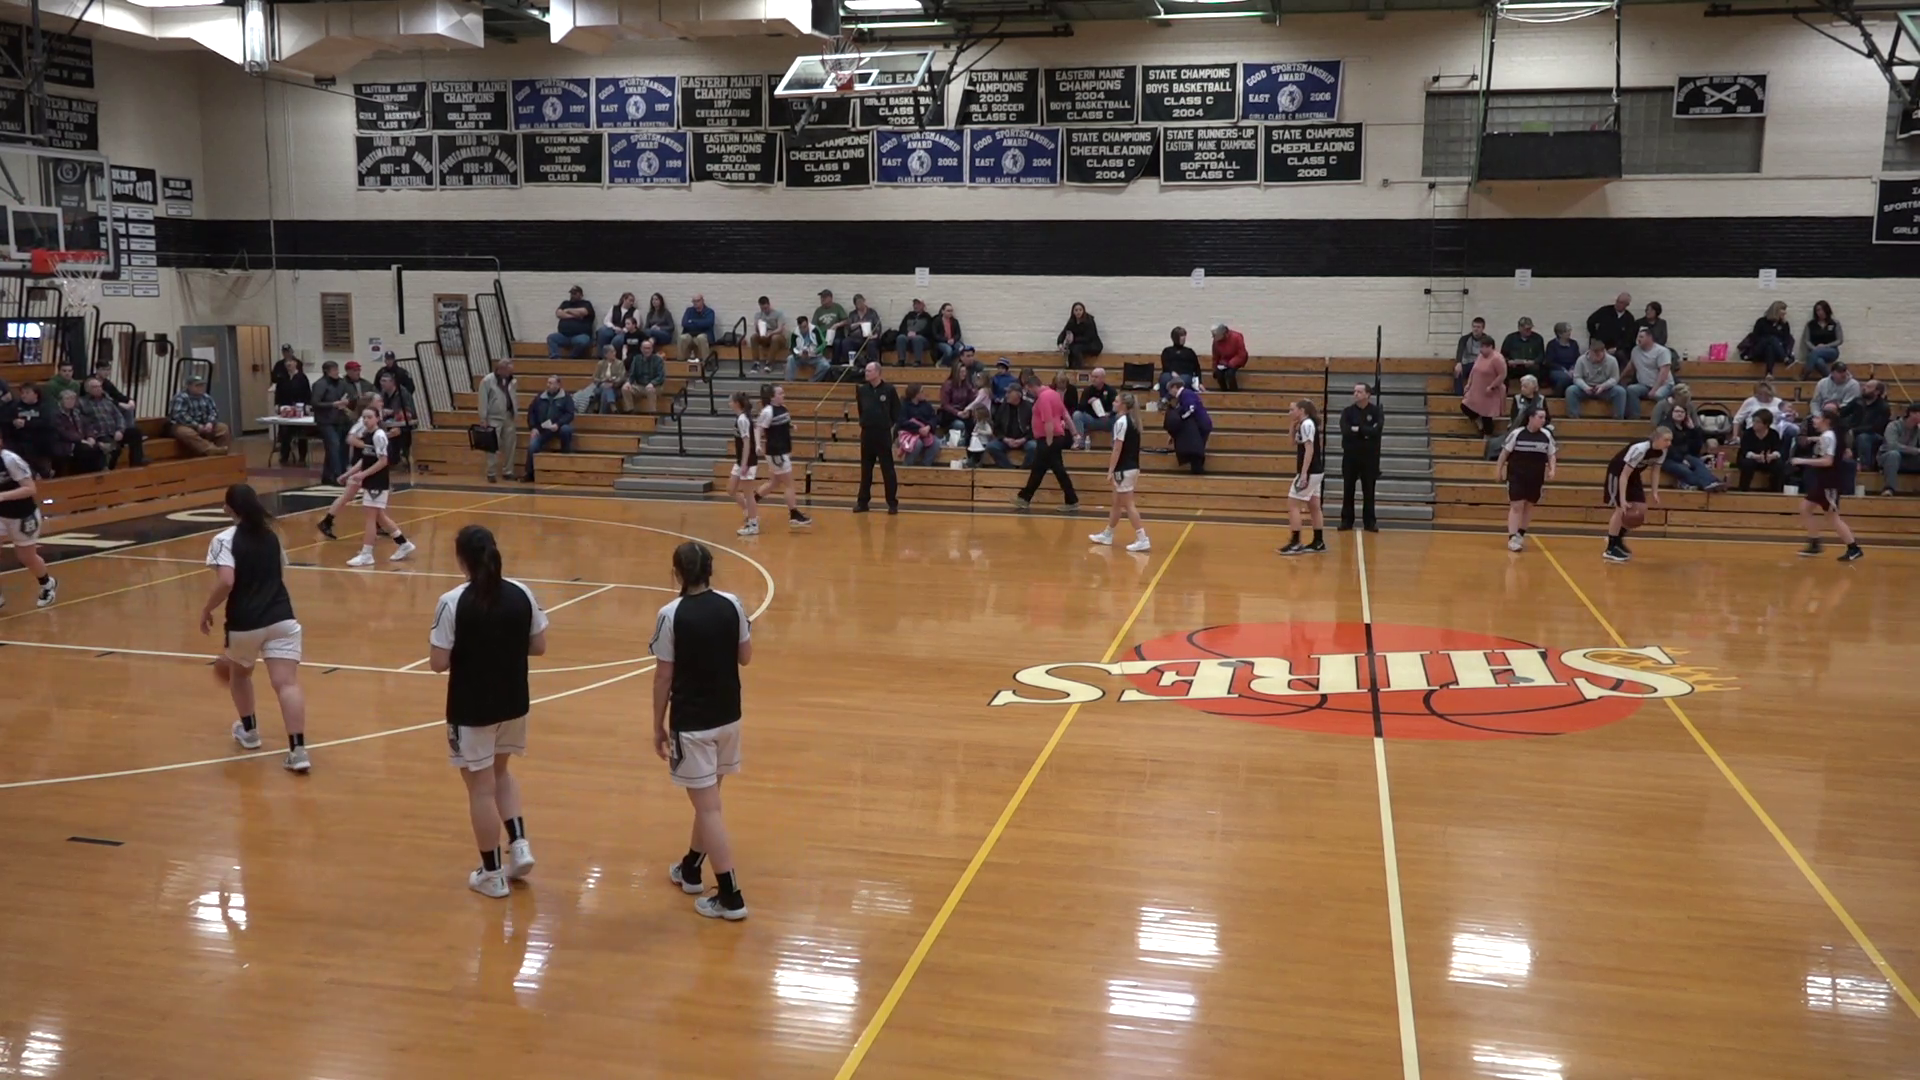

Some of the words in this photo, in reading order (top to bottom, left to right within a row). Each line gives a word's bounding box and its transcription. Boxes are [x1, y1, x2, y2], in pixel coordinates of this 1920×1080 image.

[1002, 71, 1028, 81] MAINE
[1055, 71, 1095, 81] EASTERN
[1099, 69, 1125, 79] MAINE
[1149, 70, 1177, 80] STATE
[1180, 68, 1230, 79] CHAMPIONS
[1246, 70, 1267, 86] GOOD
[1271, 63, 1335, 84] SPORTSMANSHIP
[1278, 73, 1305, 82] AWARD
[432, 82, 473, 92] EASTERN
[478, 81, 507, 91] MAINE
[682, 77, 728, 88] EASTERN
[730, 76, 762, 87] MAINE
[1059, 80, 1121, 91] CHAMPIONS
[362, 85, 391, 93] EASTERN
[397, 84, 417, 92] MAINE
[535, 79, 588, 99] SPORTSMANSHIP
[540, 87, 563, 95] AWARD
[619, 78, 672, 98] SPORTSMANSHIP
[625, 86, 647, 94] AWARD
[1146, 83, 1169, 94] BOYS
[1173, 81, 1232, 93] BASKETBALL
[444, 92, 495, 103] CHAMPIONS
[694, 88, 751, 99] CHAMPIONS
[980, 94, 1009, 102] 2003
[1075, 91, 1105, 100] 2004
[373, 94, 408, 103] CHAMPIONS
[864, 97, 887, 106] GIRLS
[1164, 96, 1201, 105] CLASS
[1206, 96, 1214, 104] C
[1249, 94, 1270, 103] EAST
[601, 104, 618, 112] EAST
[714, 100, 732, 108] 1997
[992, 103, 1024, 112] SOCCER
[1050, 101, 1072, 110] BOYS
[1075, 100, 1131, 109] BASKETBALL
[518, 105, 535, 113] EAST
[696, 109, 750, 117] CHEERLEADING
[879, 107, 914, 116] CLASS
[1172, 108, 1204, 118] 2004
[46, 109, 89, 124] HAMPIONS
[359, 112, 377, 120] GIRLS
[447, 112, 465, 120] GIRLS
[468, 112, 491, 120] SOCCER
[971, 113, 1006, 122] CLASS
[1009, 113, 1017, 121] C
[1067, 111, 1103, 120] CLASS
[1106, 110, 1114, 119] C
[377, 121, 399, 129] CLASS
[455, 121, 475, 129] CLASS
[707, 118, 729, 126] CLASS
[887, 117, 915, 125] 2002
[703, 134, 739, 144] EASTERN
[742, 133, 766, 143] MAINE
[1072, 132, 1099, 143] STATE
[1102, 131, 1151, 142] CHAMPIONS
[1167, 129, 1194, 140] STATE
[1197, 128, 1254, 139] RUNNERS-UP
[1272, 129, 1301, 140] STATE
[1306, 128, 1354, 139] CHAMPIONS
[536, 136, 566, 145] EASTERN
[569, 136, 589, 144] MAINE
[630, 133, 684, 153] SPORTSMANSHIP
[880, 138, 898, 153] GOOD
[901, 132, 961, 152] SPORTSMANSHIP
[973, 135, 993, 151] GOOD
[995, 128, 1055, 150] SPORTSMANSHIP
[1002, 138, 1028, 147] AWARD
[544, 145, 581, 154] CHAMPIONS
[636, 141, 659, 150] AWARD
[706, 144, 762, 154] CHAMPIONS
[907, 141, 932, 149] AWARD
[1165, 141, 1194, 151] EASTERN
[1197, 141, 1217, 150] MAINE
[1220, 140, 1256, 150] CHAMPIONS
[1271, 142, 1355, 154] CHEERLEADING
[790, 148, 865, 161] CHEERLEADING
[1070, 144, 1153, 156] CHEERLEADING
[358, 147, 407, 174] SPORTSMANSHIP
[412, 151, 434, 174] AWARD
[440, 146, 491, 174] SPORTSMANSHIP
[494, 149, 518, 174] AWARD
[722, 155, 747, 163] 2001
[1194, 152, 1225, 161] 2004
[1287, 156, 1325, 166] CLASS
[1329, 156, 1337, 164] C
[614, 159, 631, 168] EAST
[882, 158, 902, 166] EAST
[937, 158, 959, 166] 2002
[975, 158, 995, 166] EAST
[1032, 158, 1052, 166] 2004
[1086, 158, 1123, 168] CLASS
[1127, 158, 1135, 167] C
[1180, 160, 1240, 171] SOFTBALL
[539, 164, 587, 173] CHEERLEADING
[706, 163, 762, 172] CHEERLEADING
[804, 162, 840, 172] CLASS
[548, 173, 570, 182] CLASS
[712, 172, 745, 181] CLASS
[813, 174, 842, 183] 2002
[1095, 170, 1125, 179] 2004
[1185, 170, 1223, 180] CLASS
[1226, 170, 1235, 179] C
[364, 176, 381, 186] GIRLS
[390, 176, 427, 187] BASKETBALL
[446, 176, 464, 186] GIRLS
[472, 175, 512, 187] BASKETBALL
[1893, 226, 1919, 234] GIRLS
[989, 646, 1694, 706] SHIRES
